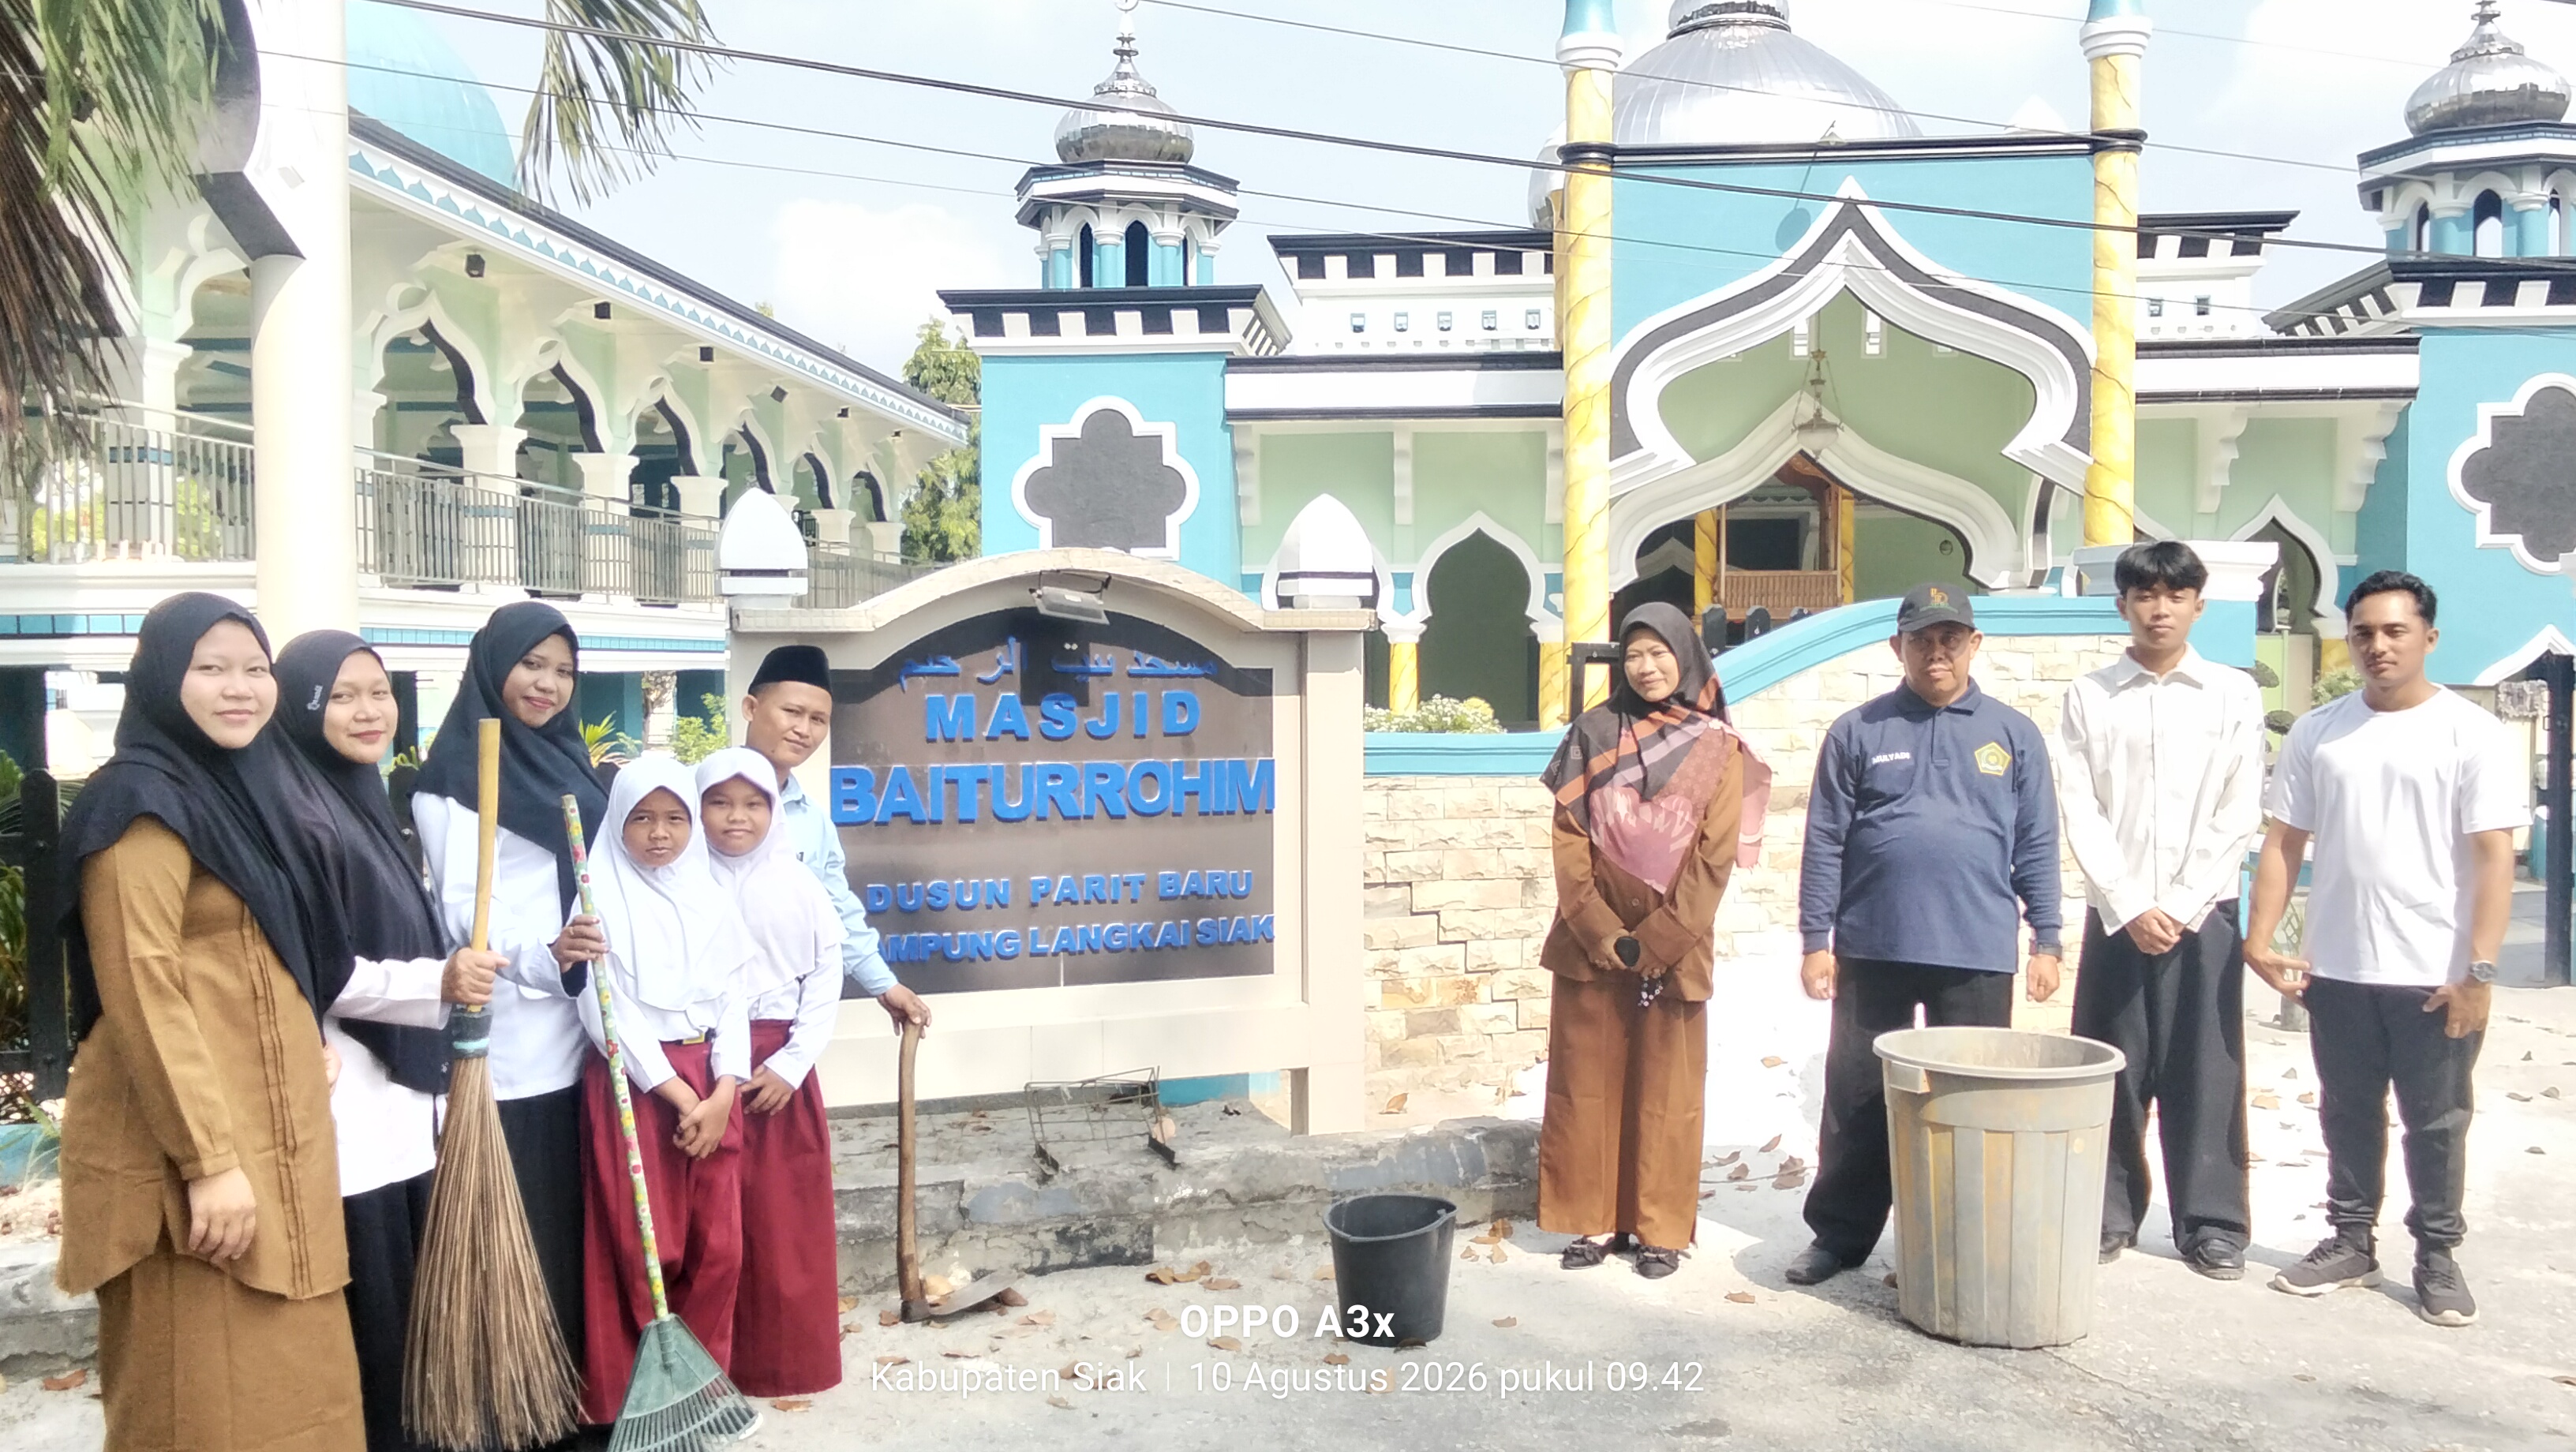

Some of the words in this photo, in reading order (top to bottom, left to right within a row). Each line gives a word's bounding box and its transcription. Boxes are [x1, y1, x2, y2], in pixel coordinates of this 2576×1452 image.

[925, 690, 1201, 742] MASJID
[830, 758, 1275, 825] BAITURROHIM
[867, 878, 1010, 913] DUSUN
[1029, 874, 1146, 905] PARIT
[1159, 870, 1253, 900] BARU
[1029, 920, 1191, 956] LANGKAI
[1196, 914, 1275, 945] SIAK
